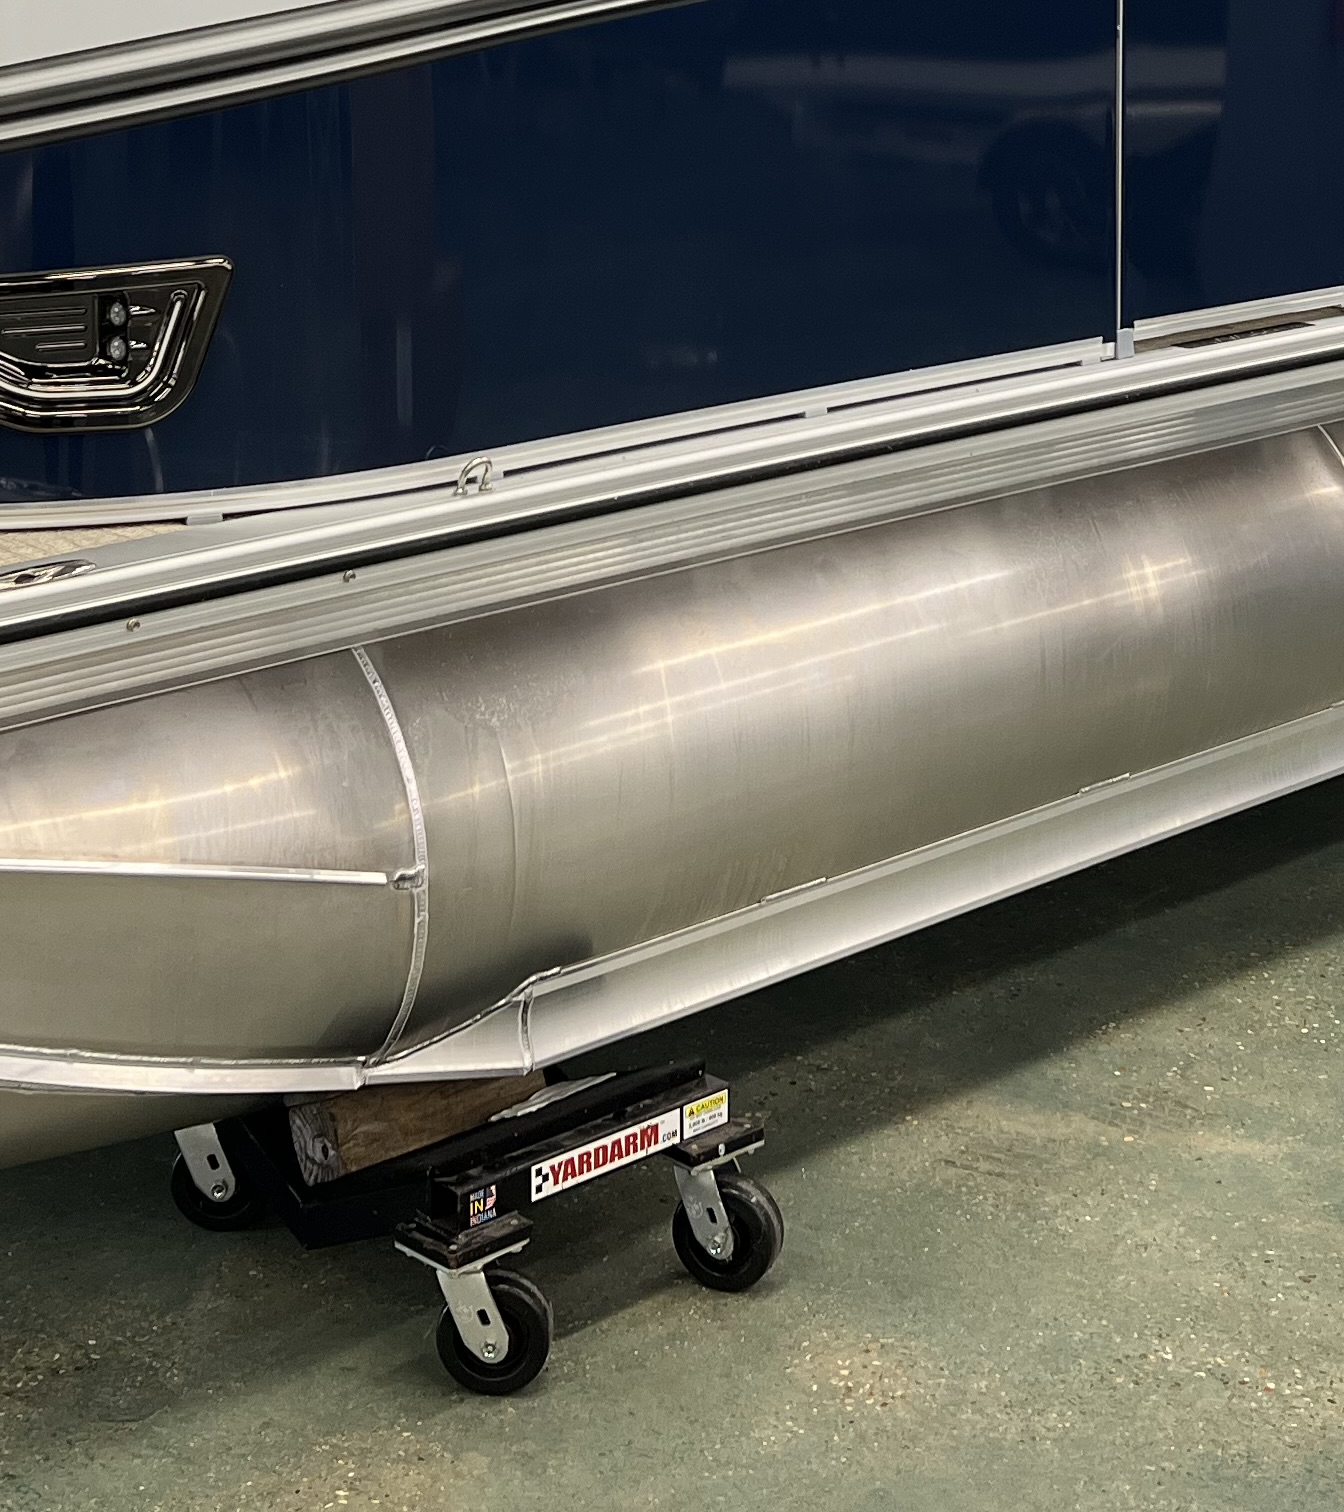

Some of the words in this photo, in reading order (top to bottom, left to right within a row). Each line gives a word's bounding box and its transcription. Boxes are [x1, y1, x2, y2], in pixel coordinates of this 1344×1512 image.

[695, 1096, 724, 1112] CAUTION
[549, 1122, 659, 1186] YARDARM
[470, 1198, 484, 1216] IN
[470, 1207, 497, 1227] INDIANA
